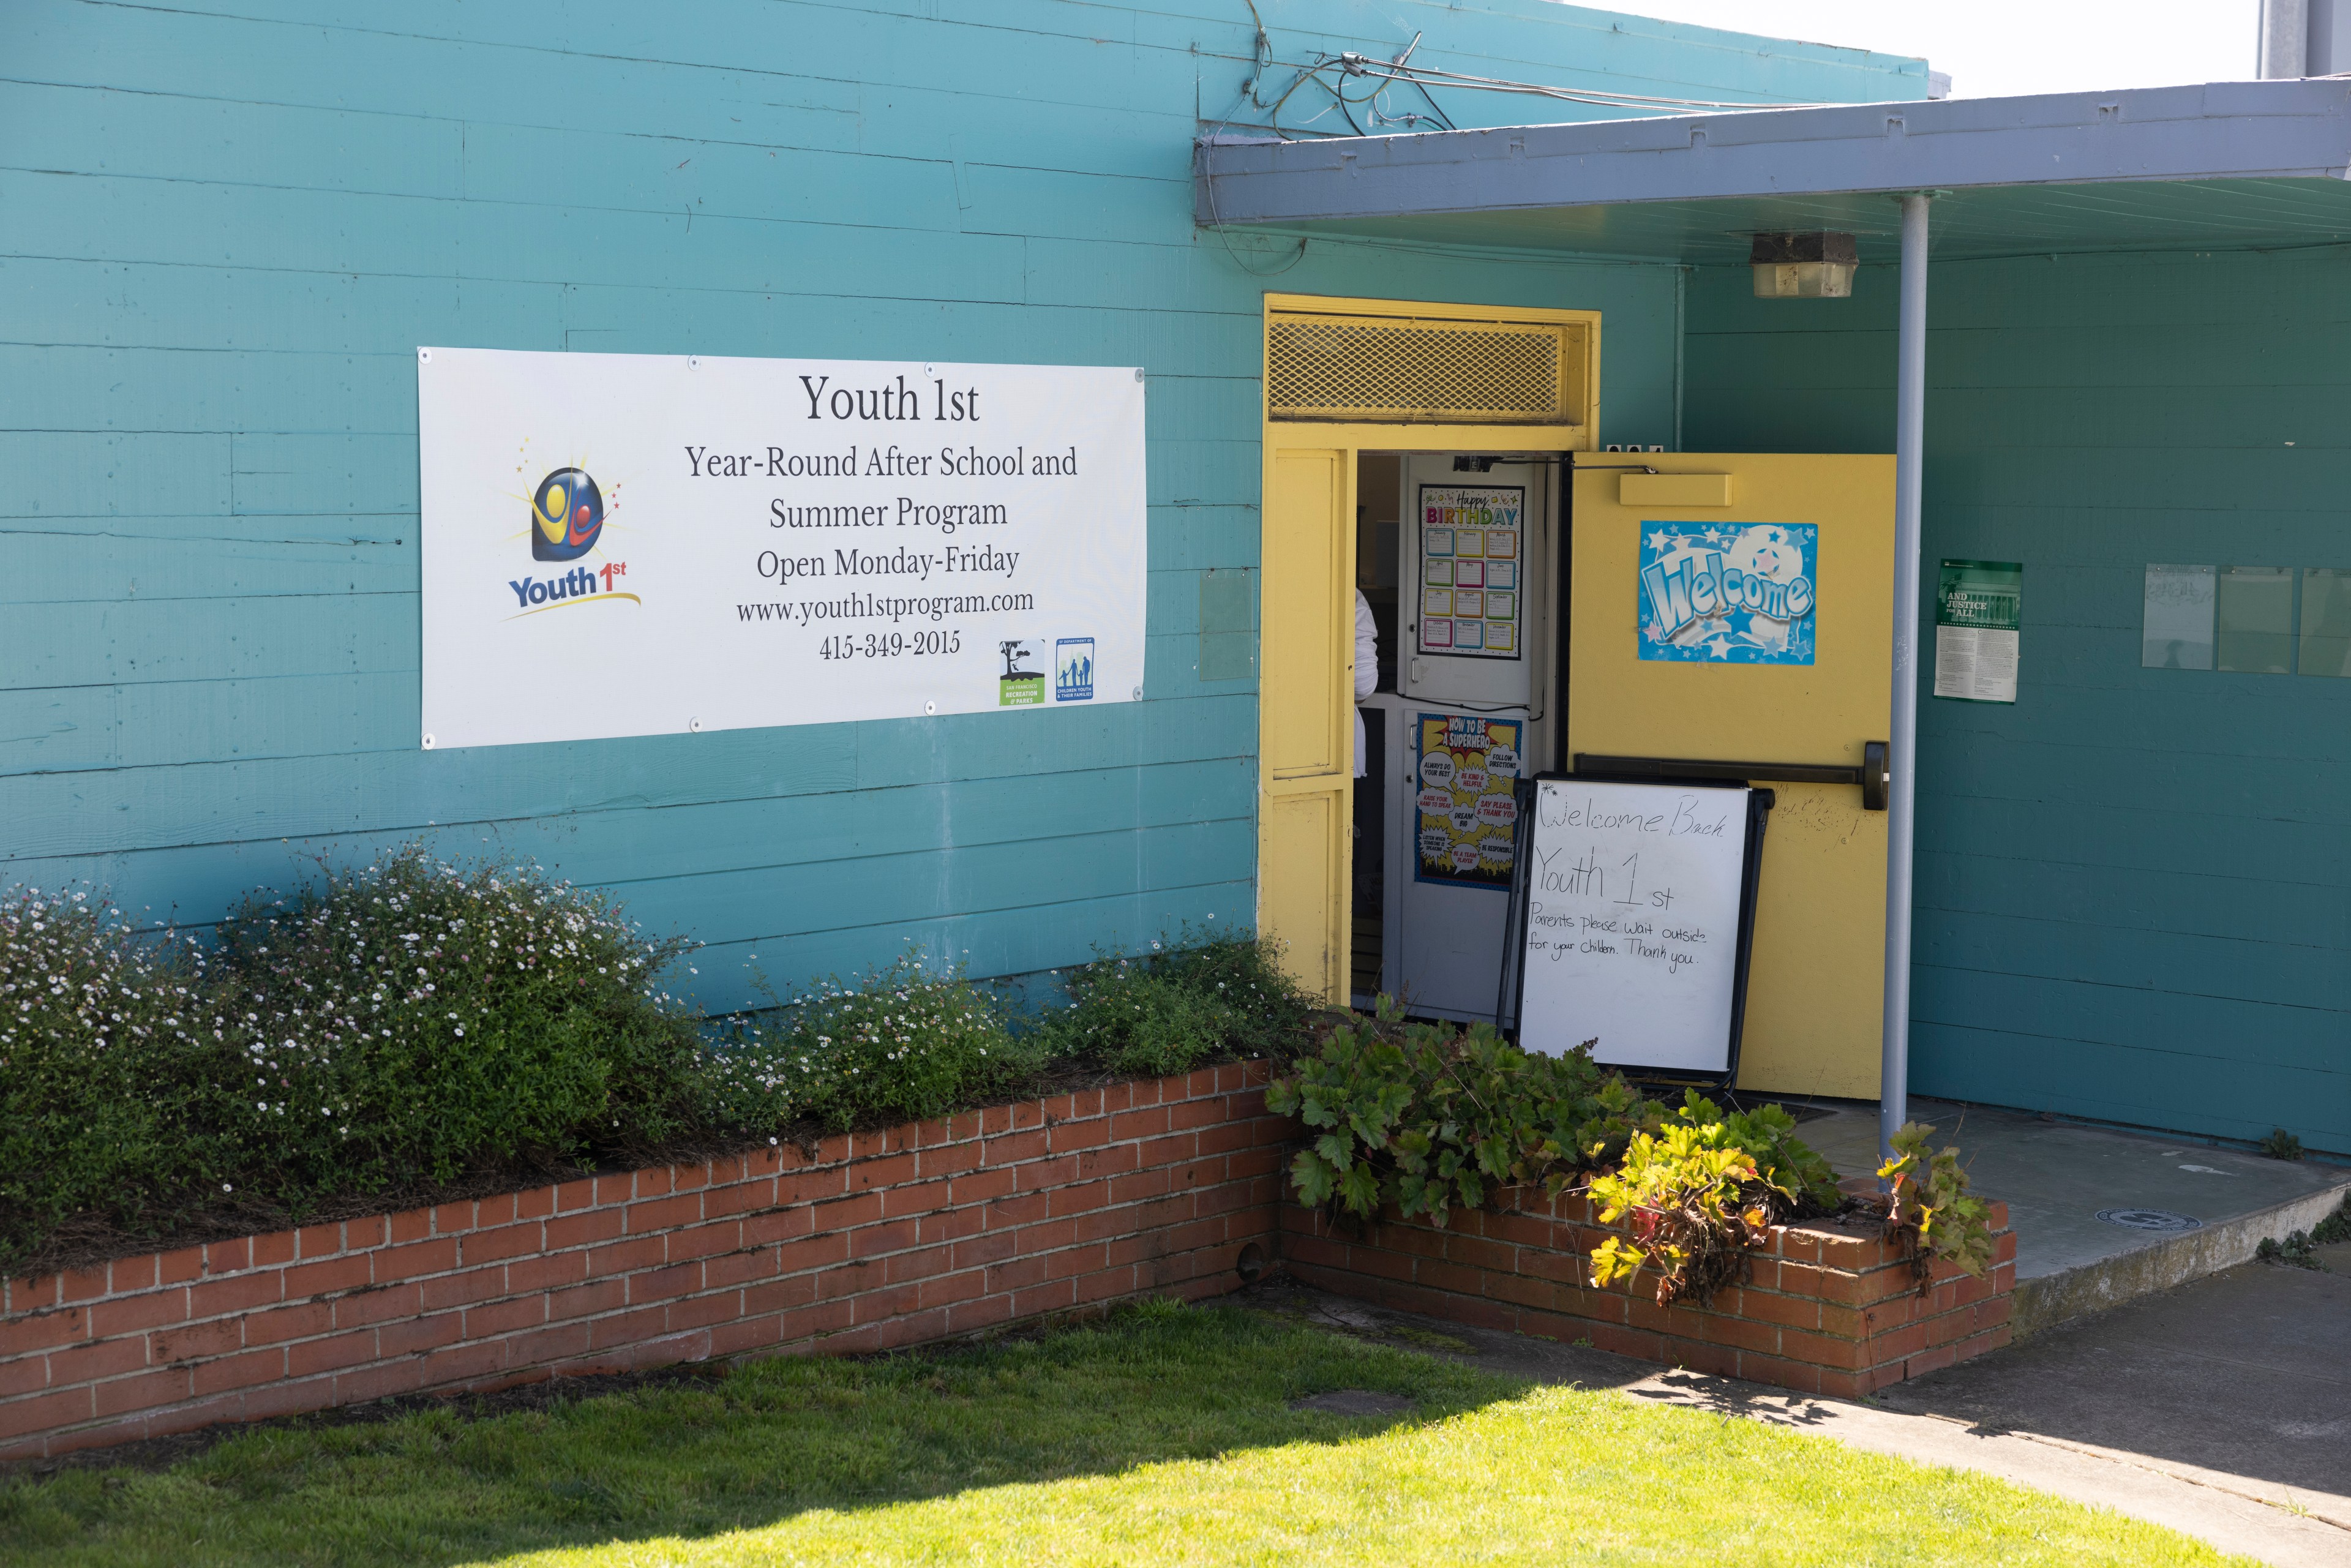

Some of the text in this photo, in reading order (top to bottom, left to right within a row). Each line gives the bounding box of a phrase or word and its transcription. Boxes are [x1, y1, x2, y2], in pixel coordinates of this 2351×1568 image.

[799, 375, 980, 421] Youth 1st
[684, 445, 1078, 476] Year-Round After School and
[770, 497, 1008, 534] Summer Program
[1425, 506, 1518, 525] BIRTHDAY
[1457, 490, 1489, 513] Happy
[757, 544, 1020, 585] Open Monday-Friday
[508, 561, 626, 607] Youth 1st
[1641, 552, 1814, 639] Welcome
[1948, 592, 1967, 601] AND
[737, 592, 1034, 627] www.youth1stprogram.com
[1946, 600, 1987, 610] JUSTICE
[820, 630, 961, 660] 415-349-2015
[1449, 717, 1486, 734] HOW TO BE
[1442, 733, 1491, 749] A SUPERHERO
[1489, 760, 1517, 769] DIRECTIONS
[1483, 808, 1501, 817] THANK
[1492, 801, 1513, 810] PLEASE
[1540, 793, 1727, 837] Welcome Back
[1535, 846, 1603, 897] Youth
[1530, 902, 1575, 928] Parents
[1528, 932, 1548, 950] for
[1551, 942, 1575, 961] your
[1623, 938, 1667, 959] Thank
